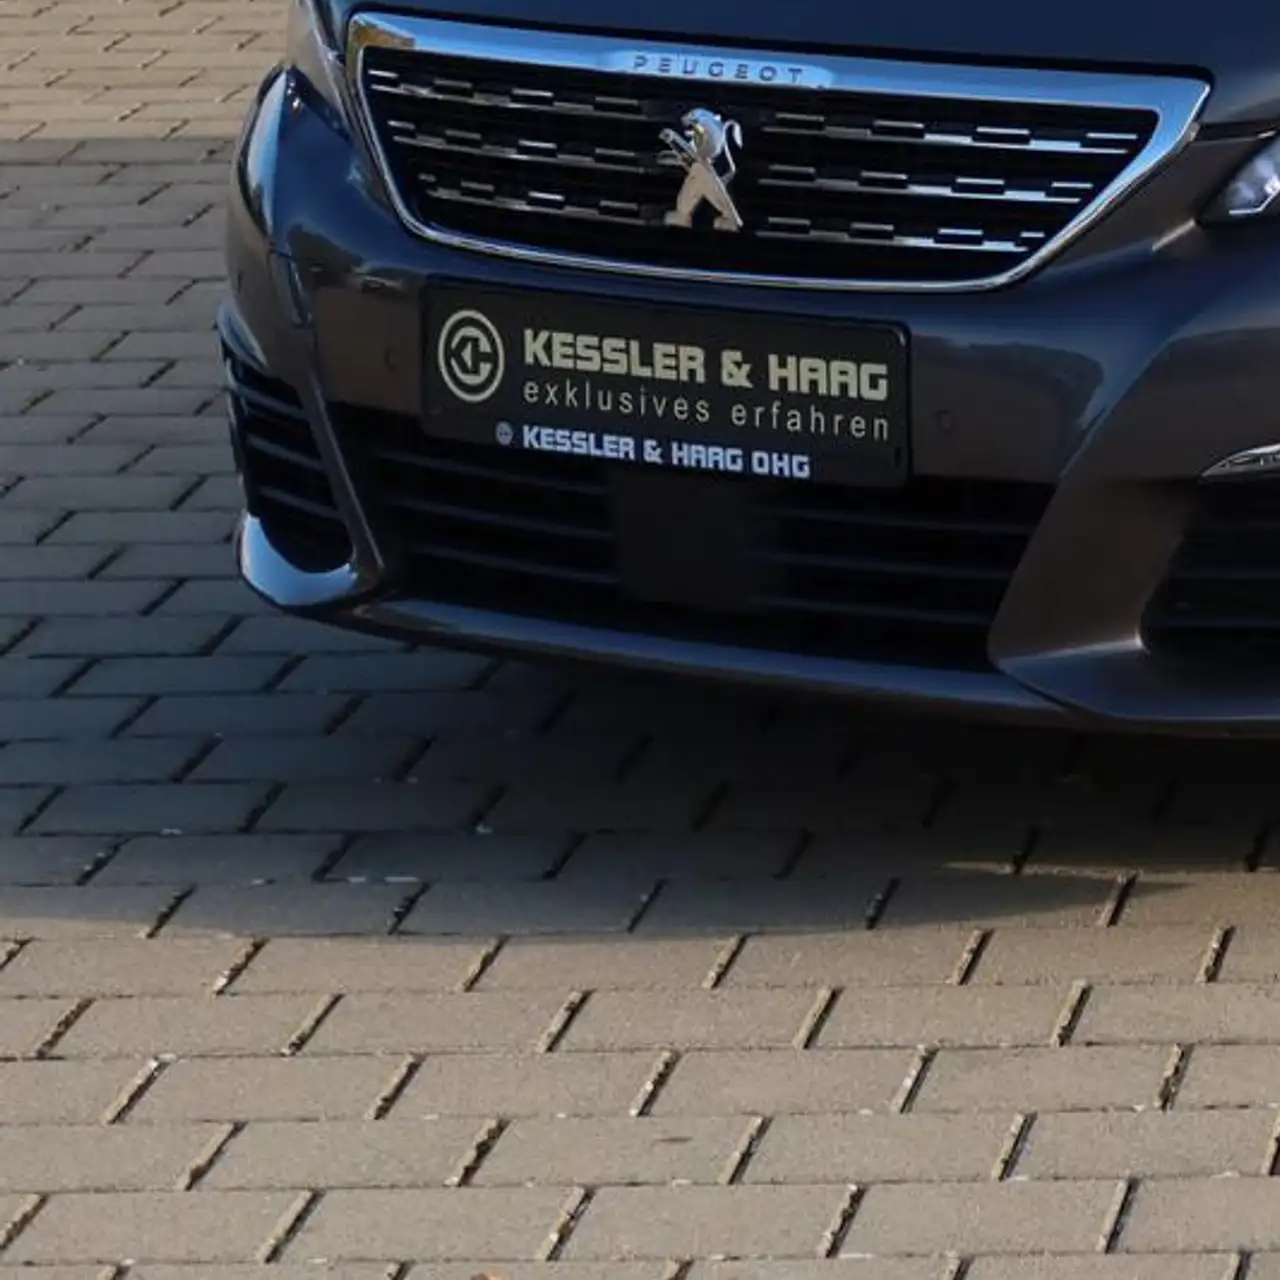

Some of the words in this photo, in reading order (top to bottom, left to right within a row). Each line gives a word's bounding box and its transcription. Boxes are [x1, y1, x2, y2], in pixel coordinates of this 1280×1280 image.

[634, 55, 803, 84] PEUGEOT
[524, 329, 705, 383] KESSLER
[721, 349, 753, 388] &
[768, 354, 888, 401] HAAG
[524, 378, 709, 422] exklusives
[732, 400, 888, 441] erfahren
[523, 425, 635, 460] KESSLER
[643, 440, 663, 464] &
[672, 442, 743, 471] HAAG
[752, 451, 810, 479] OHG
